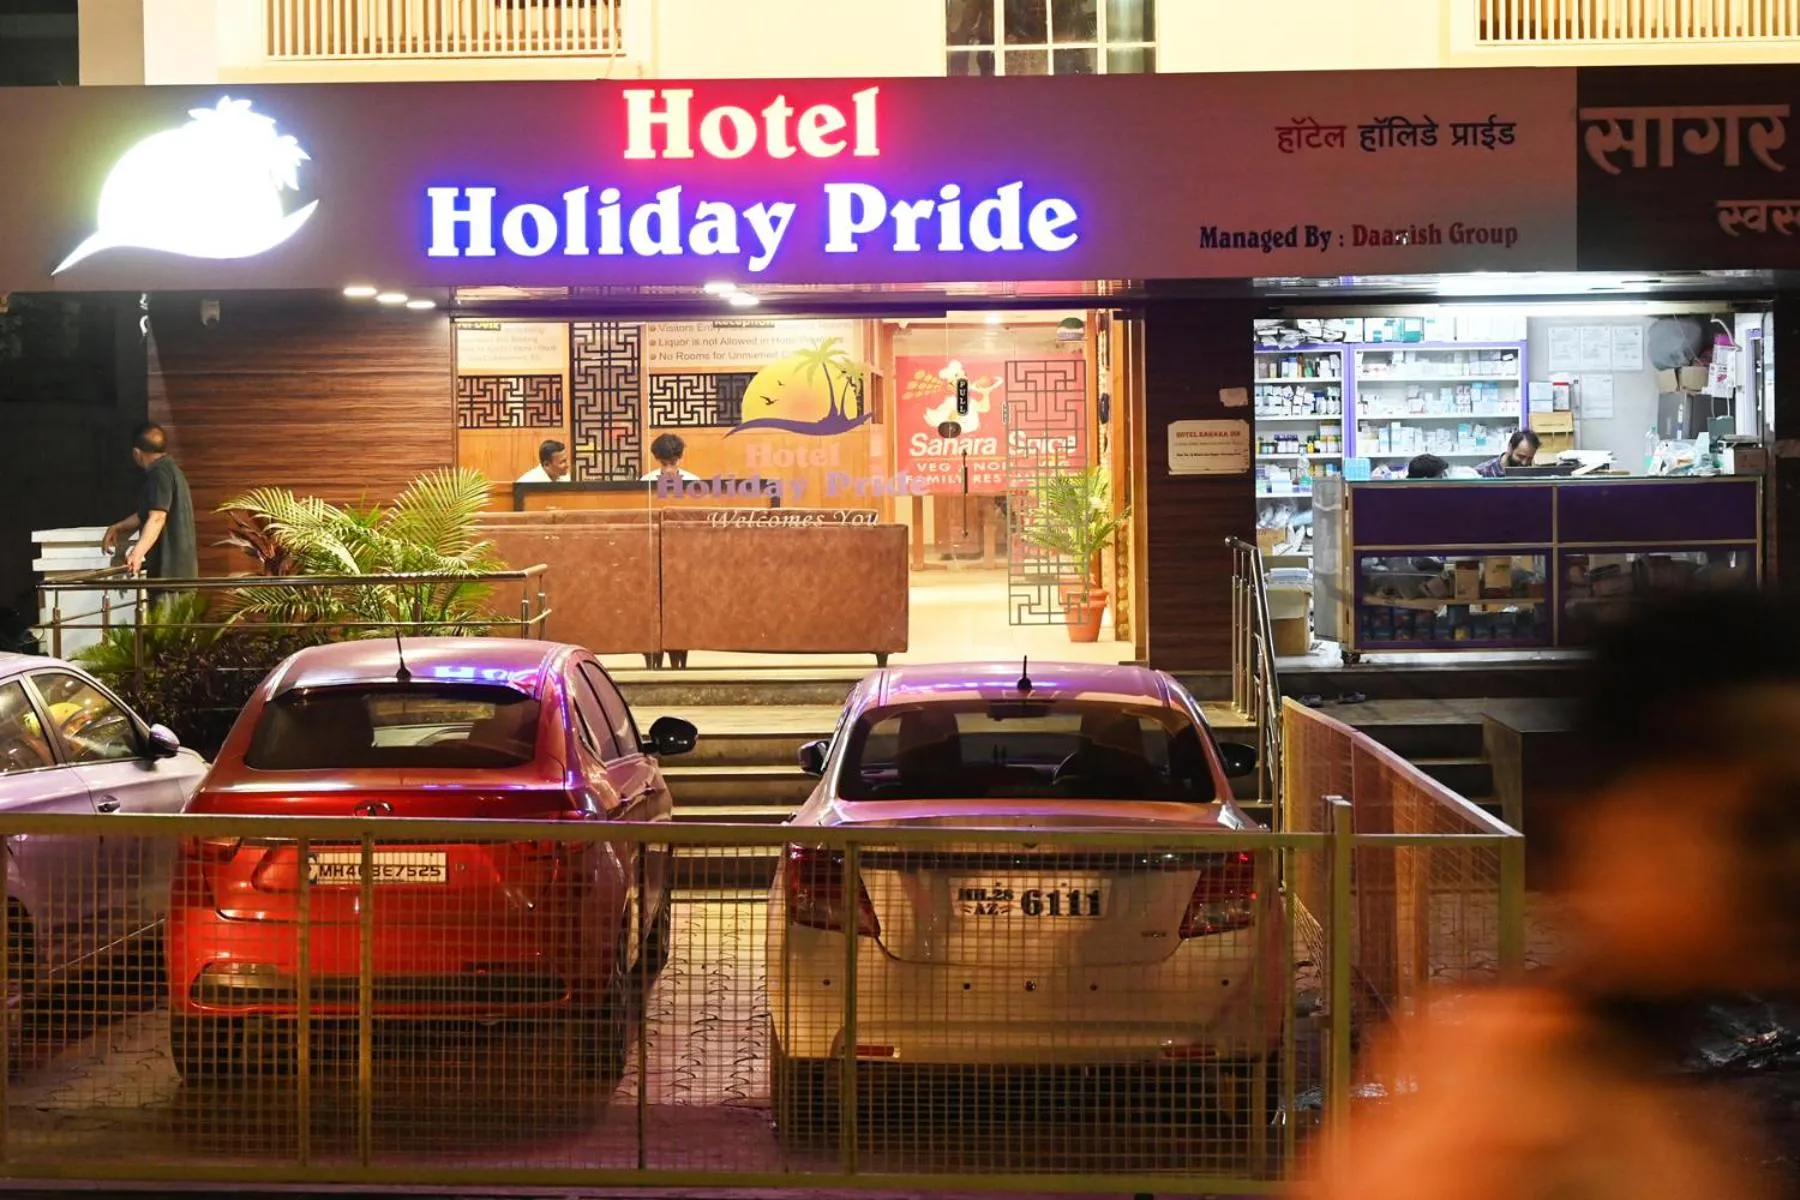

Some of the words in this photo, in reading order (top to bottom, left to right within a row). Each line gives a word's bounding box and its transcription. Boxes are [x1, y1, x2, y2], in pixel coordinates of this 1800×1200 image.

[623, 86, 880, 159] Hotel
[1276, 116, 1347, 153] हॉटेल
[1357, 115, 1439, 152] हॉलिडे
[1449, 115, 1517, 151] प्राईड
[1579, 104, 1790, 175] सागर
[427, 185, 796, 272] Holiday
[824, 180, 1079, 253] Pride
[1199, 225, 1299, 252] Managed
[1304, 225, 1332, 252] By
[1352, 222, 1443, 248] Daanish
[1449, 220, 1519, 249] Group
[658, 338, 690, 348] Liquor
[702, 338, 718, 347] not
[659, 351, 673, 361] No
[676, 351, 710, 361] Rooms
[958, 380, 967, 414] PULL
[745, 442, 841, 467] Hotel
[916, 462, 952, 473] VEG
[655, 472, 808, 500] Holiday
[826, 470, 932, 498] Pride
[706, 509, 826, 529] Welcomes
[833, 509, 880, 528] You
[1020, 888, 1101, 917] 6111
